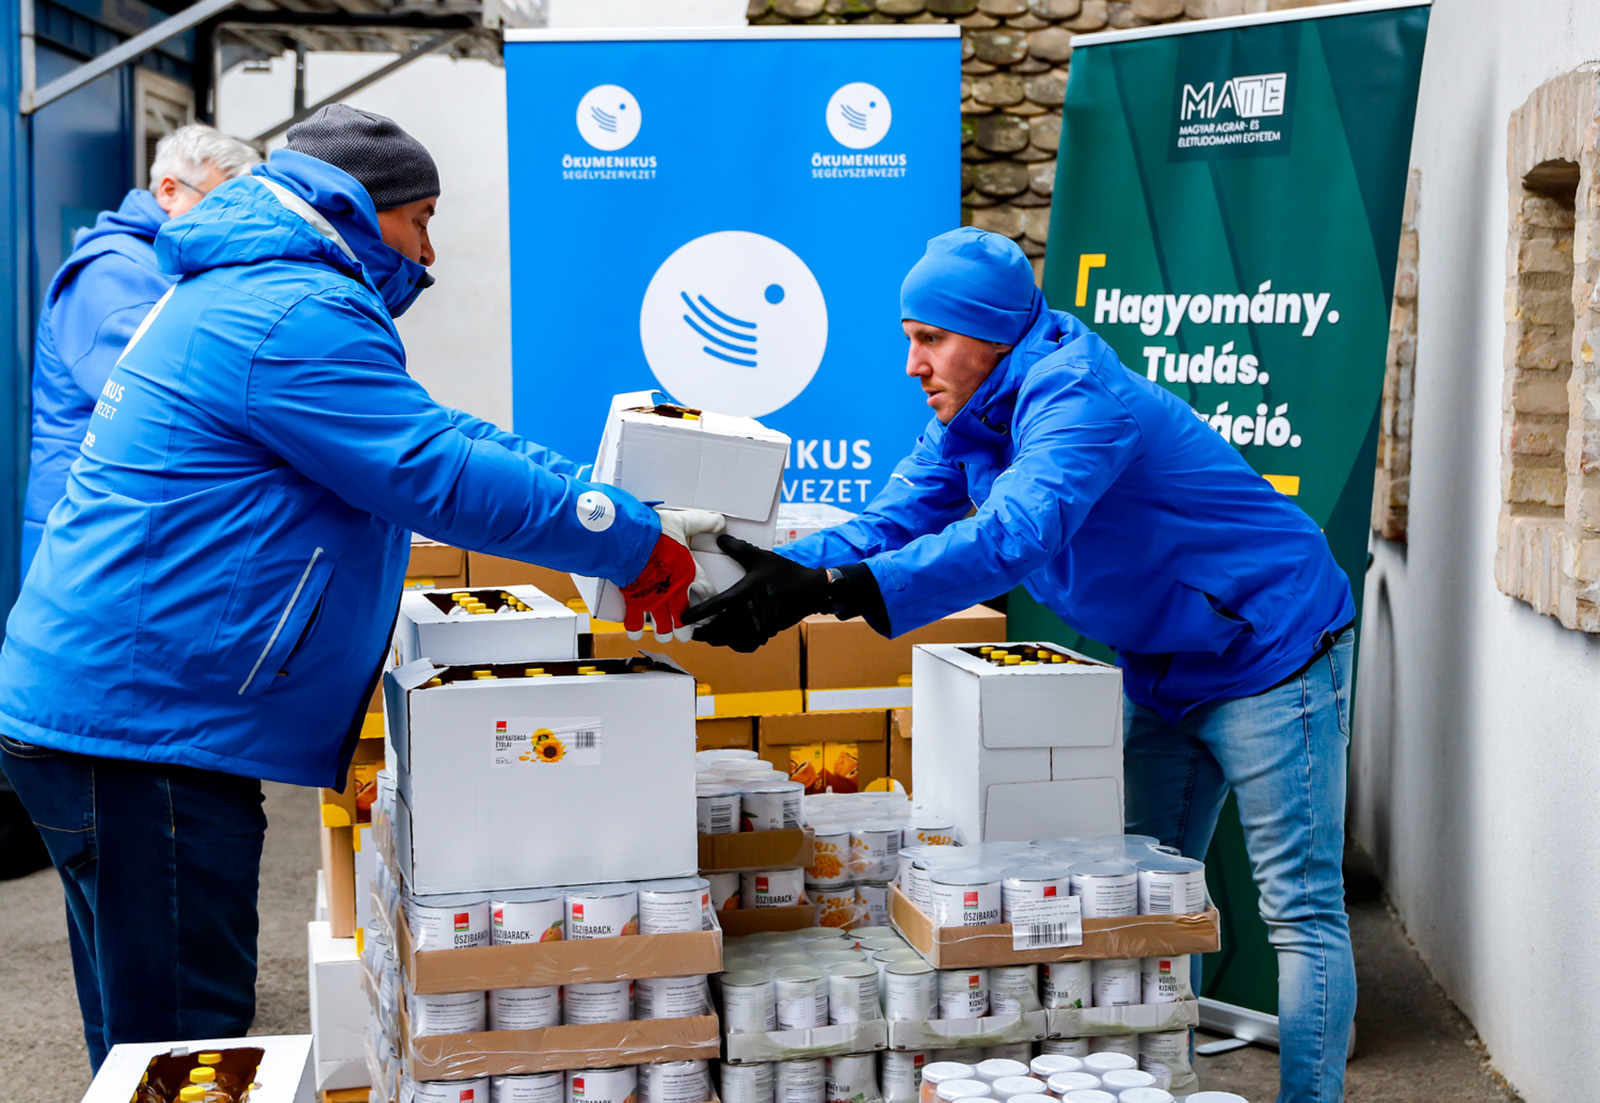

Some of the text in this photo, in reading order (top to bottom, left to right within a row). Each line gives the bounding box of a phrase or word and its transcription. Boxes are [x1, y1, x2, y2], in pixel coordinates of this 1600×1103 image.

[1180, 72, 1287, 121] MATE
[1179, 123, 1215, 135] MAGYAR
[1249, 119, 1260, 131] ÉS
[1243, 131, 1281, 144] EGYETEM
[561, 153, 658, 169] ÖKUMENIKUS
[811, 152, 908, 167] ÖKUMENIKUS
[562, 169, 657, 180] SEGÉLYSZERVEZET
[811, 167, 907, 179] SEGÉLYSZERVEZET
[1094, 279, 1340, 337] Hagyomány.
[1143, 340, 1270, 385] Tudás.
[1192, 401, 1302, 448] áció.
[784, 438, 872, 470] IKUS
[782, 479, 872, 503] VEZET
